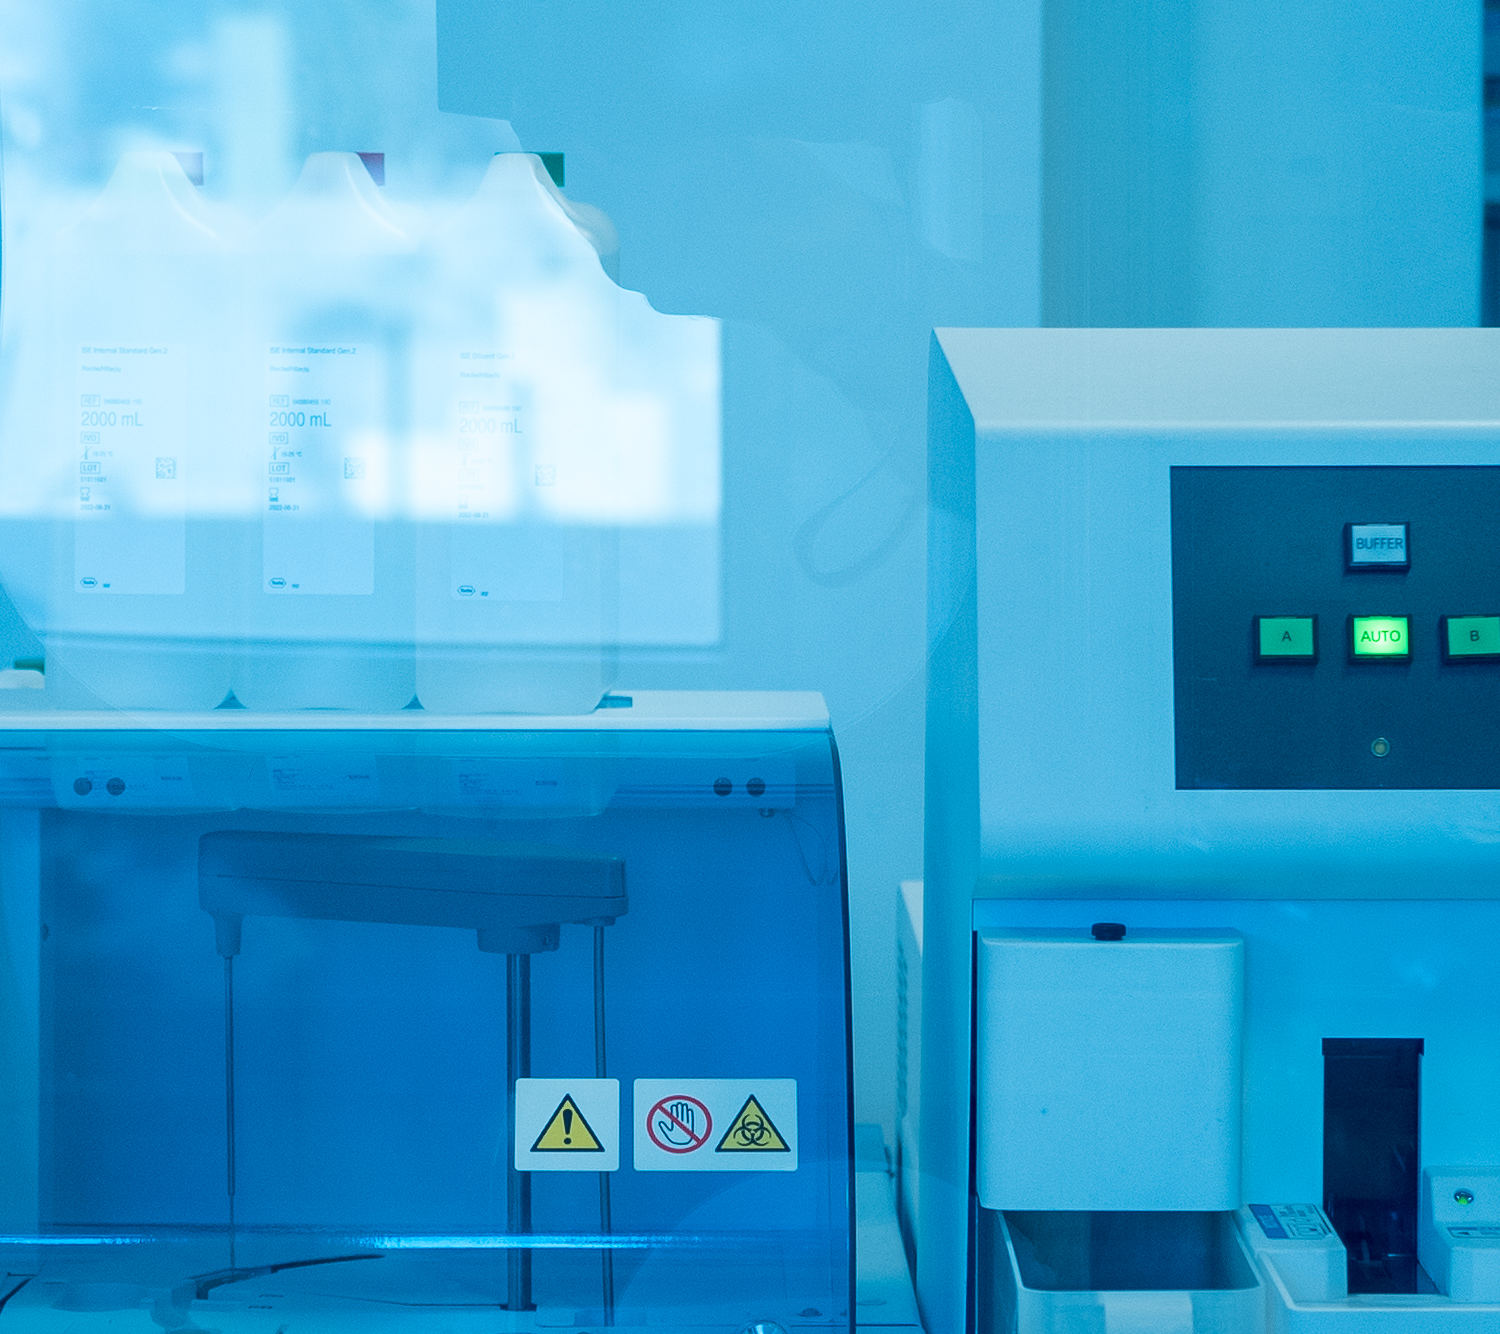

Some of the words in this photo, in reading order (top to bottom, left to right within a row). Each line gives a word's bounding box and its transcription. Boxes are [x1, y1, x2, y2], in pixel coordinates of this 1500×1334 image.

[81, 411, 117, 427] 2000
[121, 411, 144, 427] mL
[269, 411, 305, 427] 2000
[310, 411, 332, 427] mL
[459, 418, 496, 433] 2000
[500, 418, 523, 433] mL
[1355, 537, 1404, 550] BUFFER
[1281, 631, 1292, 642] A
[1360, 630, 1401, 643] AUTO
[1470, 631, 1479, 642] B
